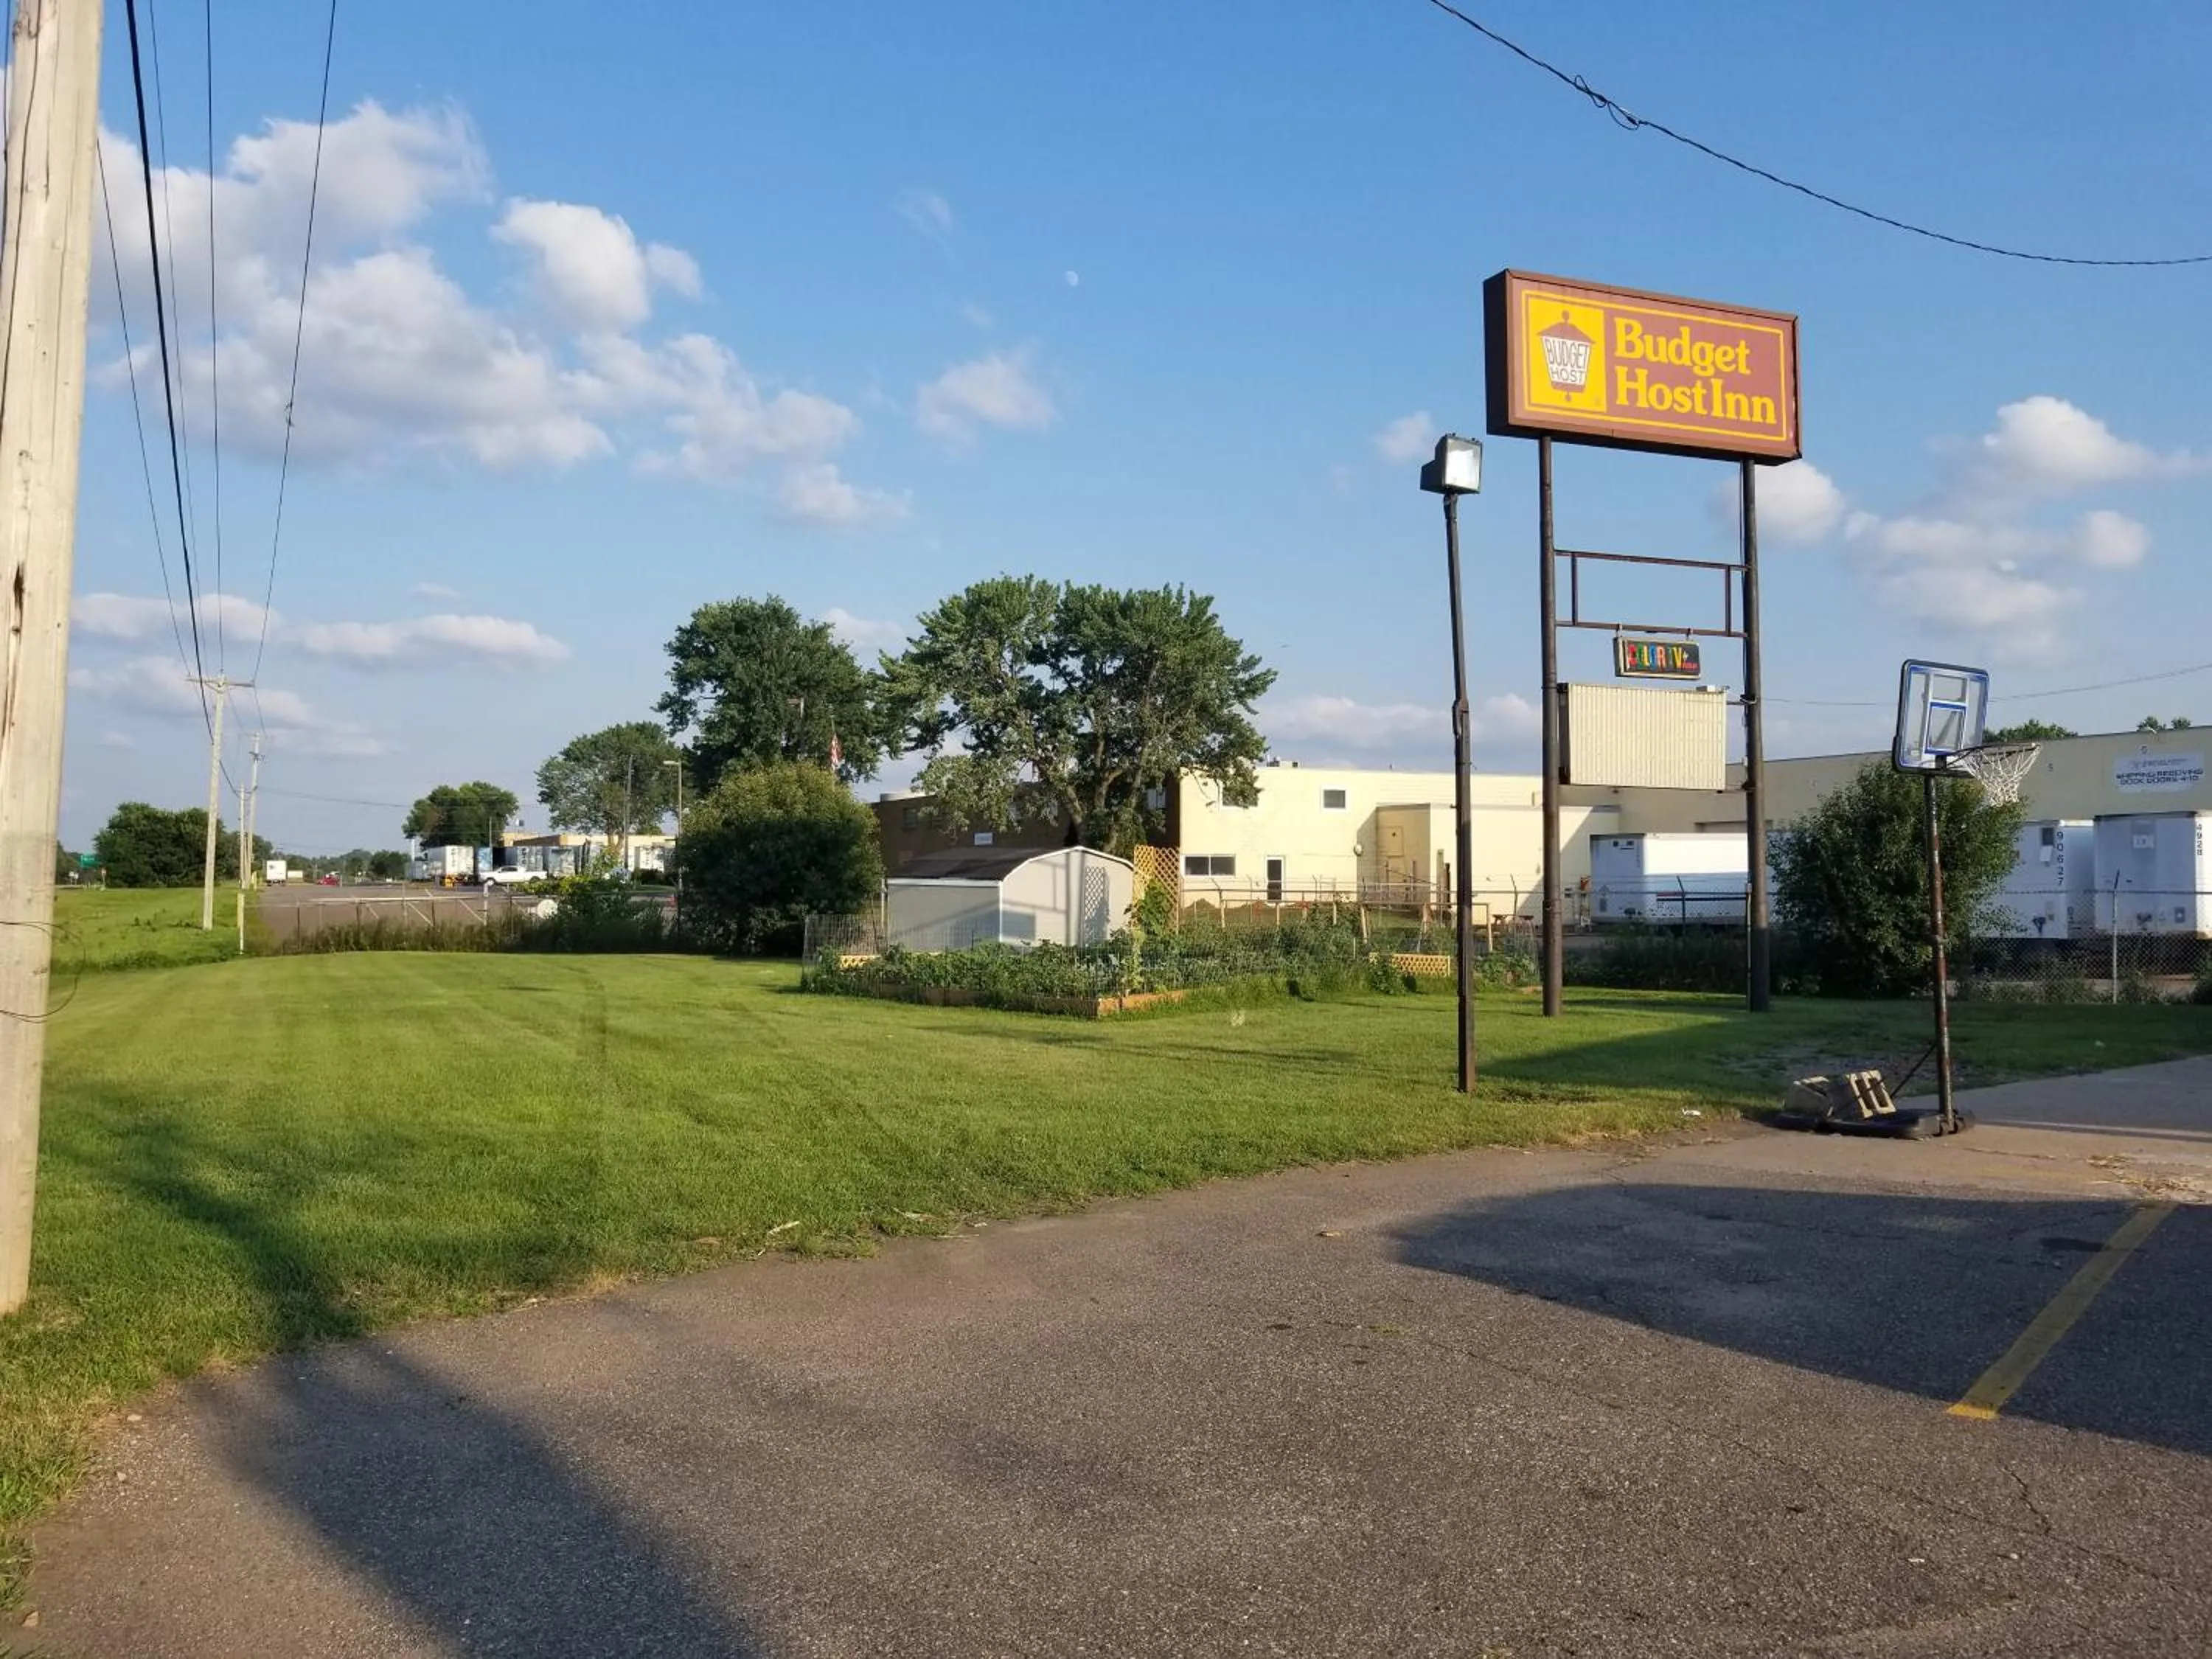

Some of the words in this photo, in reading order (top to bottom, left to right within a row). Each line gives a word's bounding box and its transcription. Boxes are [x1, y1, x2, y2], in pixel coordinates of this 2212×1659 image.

[1545, 338, 1588, 369] BUDGET
[1613, 317, 1752, 377] Budget
[1550, 368, 1584, 383] HOST
[1615, 365, 1708, 416] Host
[1710, 378, 1778, 425] Inn
